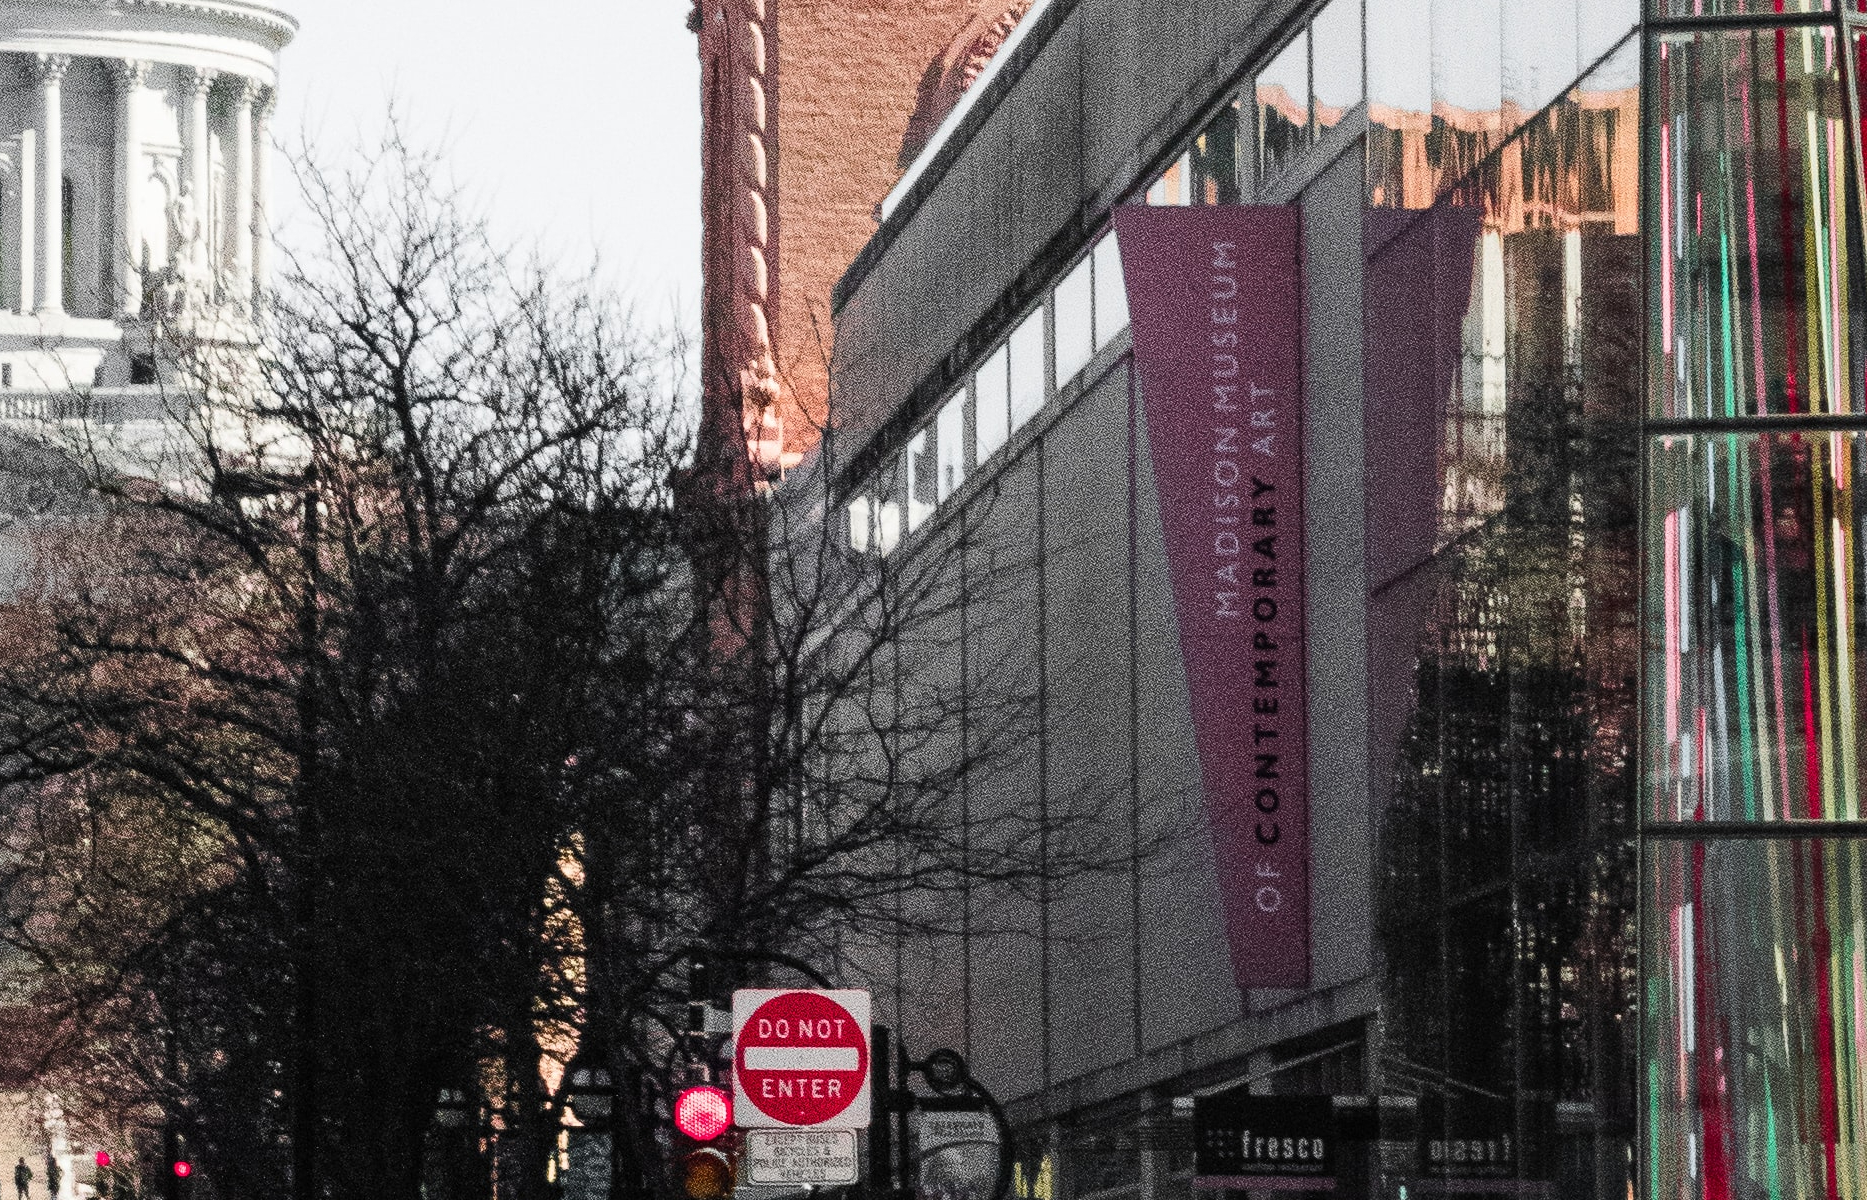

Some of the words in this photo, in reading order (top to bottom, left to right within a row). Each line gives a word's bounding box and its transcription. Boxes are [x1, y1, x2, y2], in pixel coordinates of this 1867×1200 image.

[1211, 240, 1239, 412] MUSEUM
[1249, 381, 1276, 458] ART
[1214, 426, 1240, 619] MADISON
[1251, 476, 1281, 846] CONTEMPORARY
[1255, 861, 1283, 913] OF
[758, 1018, 791, 1040] DO
[798, 1018, 846, 1040] NOT
[761, 1078, 842, 1100] ENTER
[1242, 1129, 1325, 1160] fresco
